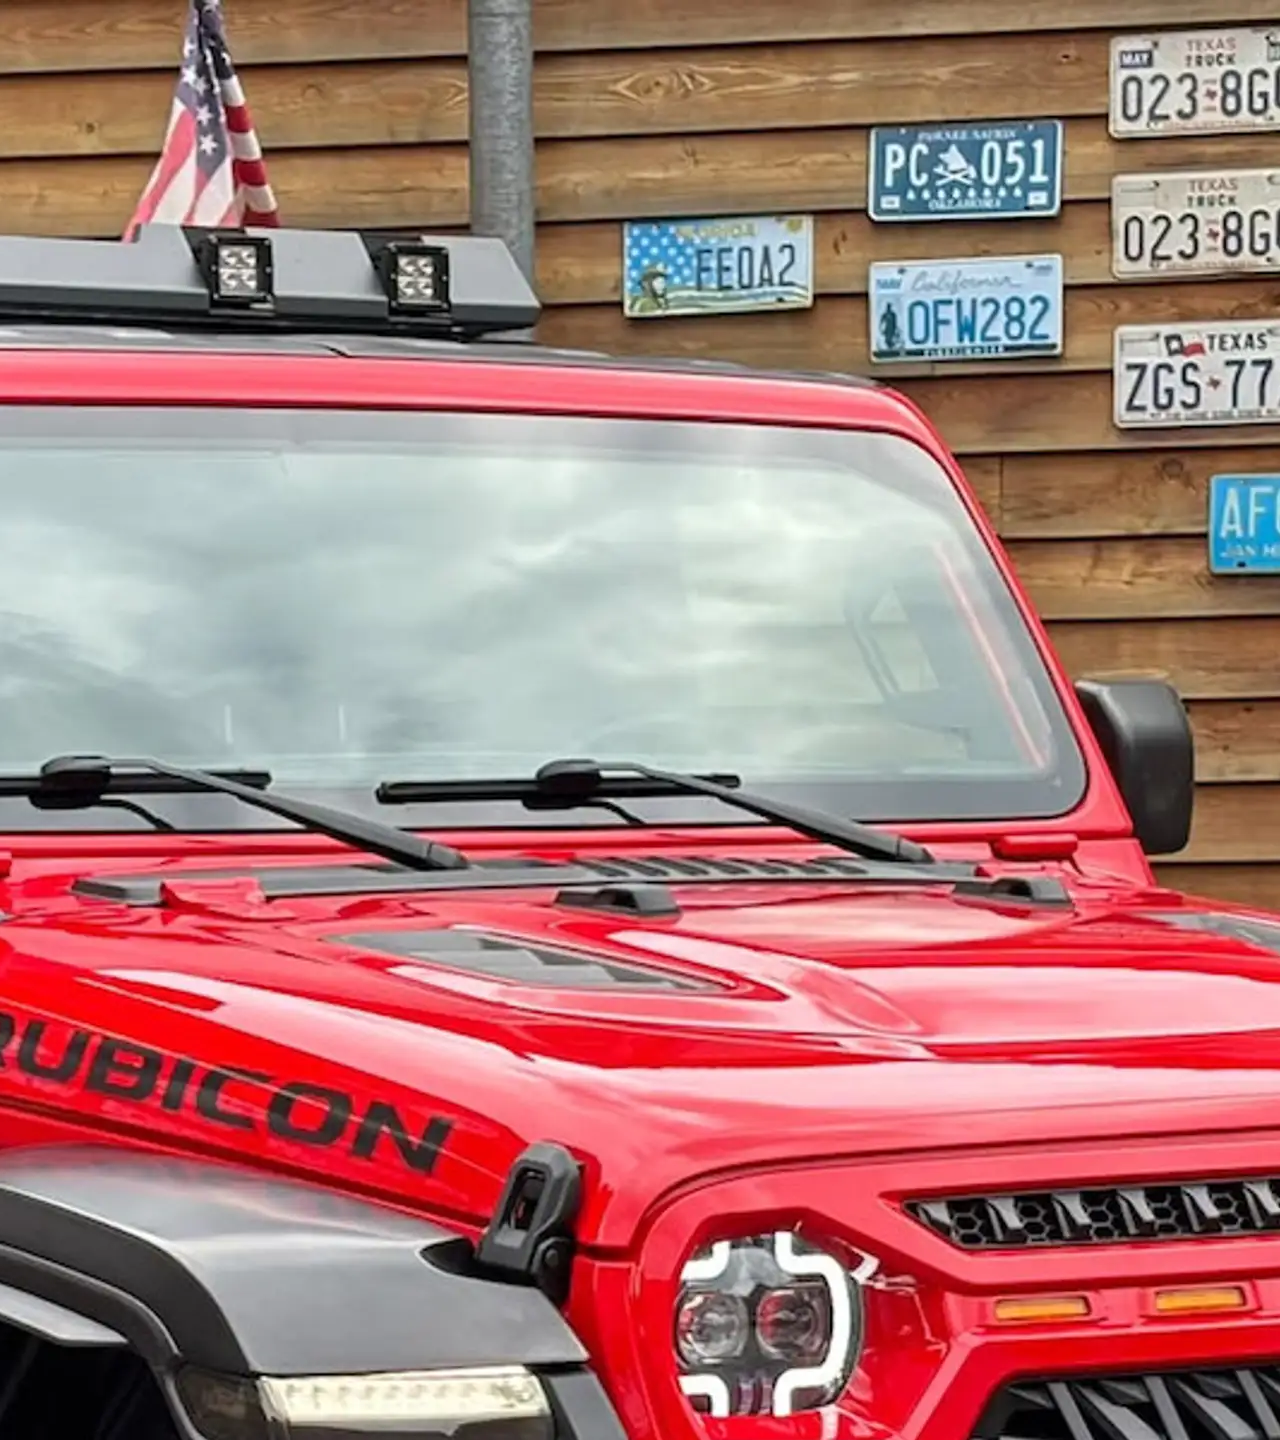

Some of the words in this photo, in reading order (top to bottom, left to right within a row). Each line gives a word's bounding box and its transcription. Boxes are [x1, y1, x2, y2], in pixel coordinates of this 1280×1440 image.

[1186, 37, 1237, 51] TEXAS
[1184, 53, 1237, 68] TRUCK
[1188, 178, 1239, 193] TEXAS
[1187, 194, 1237, 207] TRUCK
[911, 270, 1021, 294] California
[1207, 332, 1268, 351] TEXAS
[1125, 361, 1201, 412] ZGS
